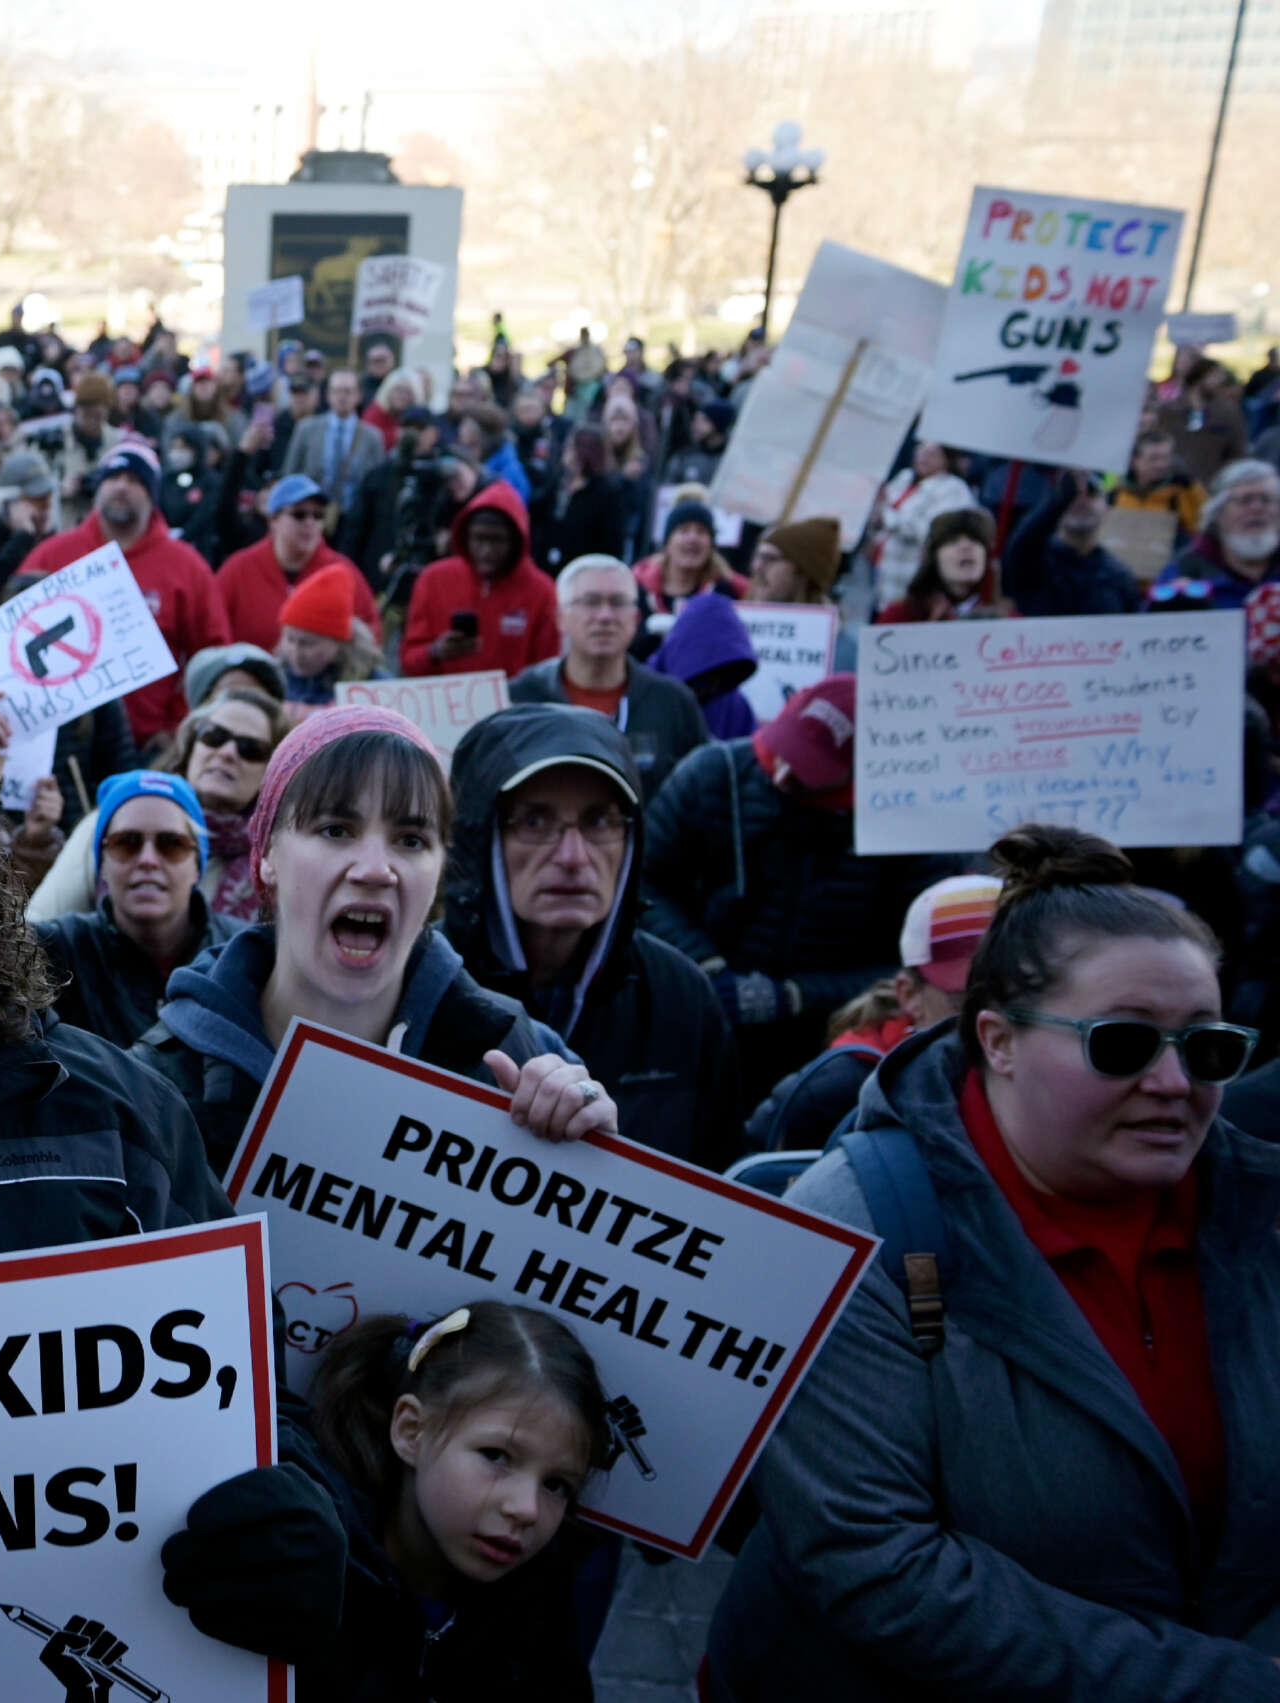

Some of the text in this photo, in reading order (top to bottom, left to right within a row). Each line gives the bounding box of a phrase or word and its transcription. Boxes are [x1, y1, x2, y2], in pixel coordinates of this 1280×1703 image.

[981, 198, 1169, 257] PROTECT
[1085, 273, 1159, 312] NOT
[1000, 310, 1123, 356] GUNS
[748, 622, 797, 639] RITZE
[873, 630, 961, 676] Since
[1140, 635, 1209, 656] more
[867, 691, 939, 716] than
[867, 724, 928, 747] have
[938, 723, 998, 742] been
[1160, 703, 1200, 727] by
[865, 751, 940, 779] school
[870, 789, 919, 811] are
[931, 783, 968, 804] we
[381, 1114, 725, 1280] PRIORITZE
[251, 1153, 787, 1388] MENTAL HEALTH!
